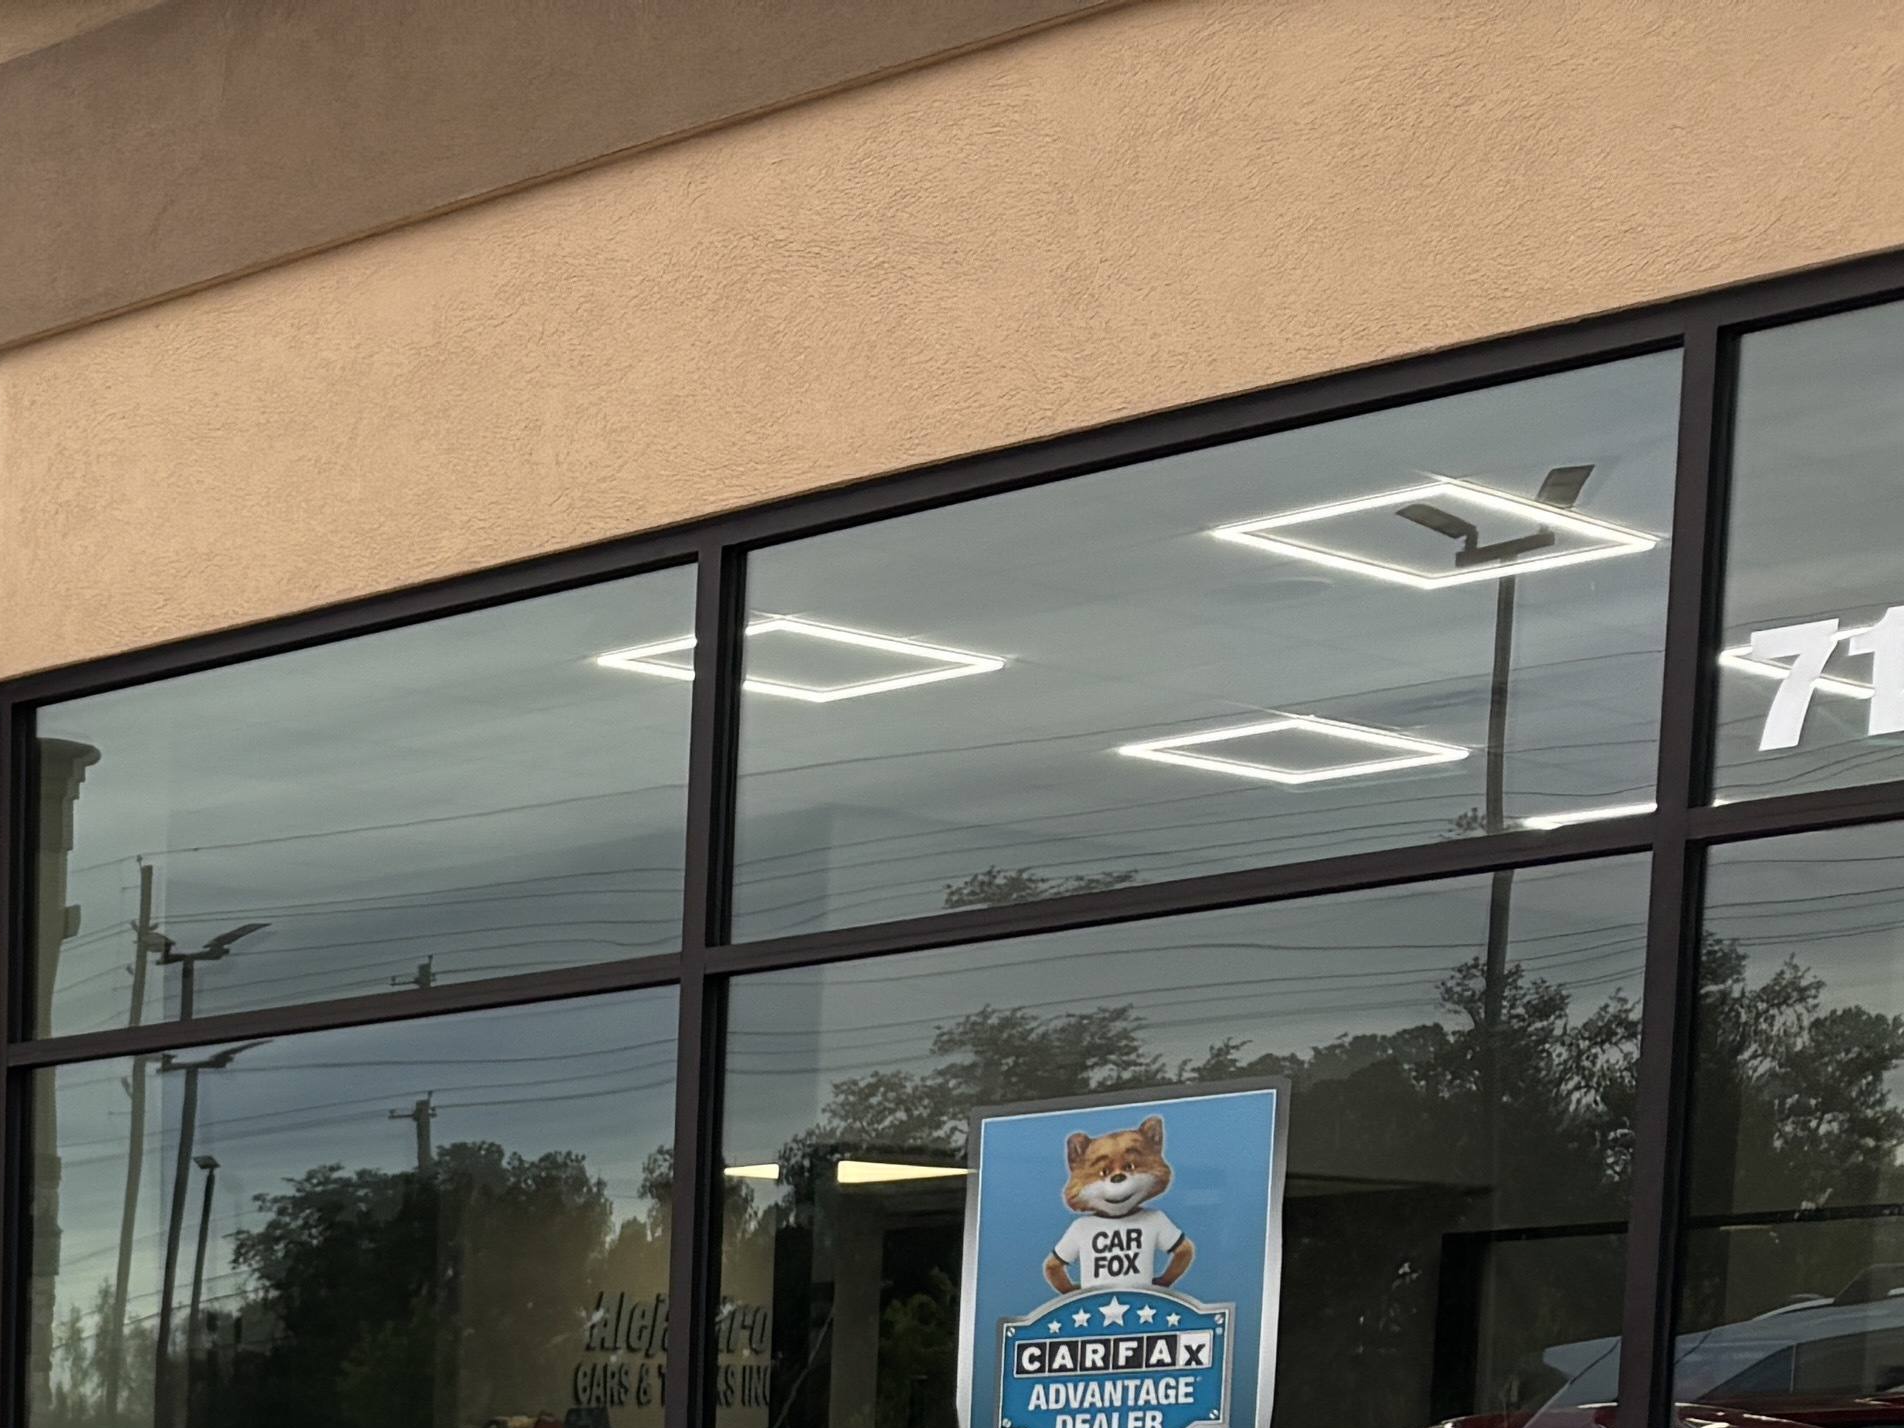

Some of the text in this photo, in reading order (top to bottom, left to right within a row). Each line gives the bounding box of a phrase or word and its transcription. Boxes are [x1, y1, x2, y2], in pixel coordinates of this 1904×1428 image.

[1092, 1228, 1142, 1254] CAR
[1094, 1253, 1141, 1278] FOX
[1020, 1336, 1209, 1374] CARFAX
[574, 1362, 631, 1406] CARS
[1028, 1376, 1195, 1410] ADVANTAGE
